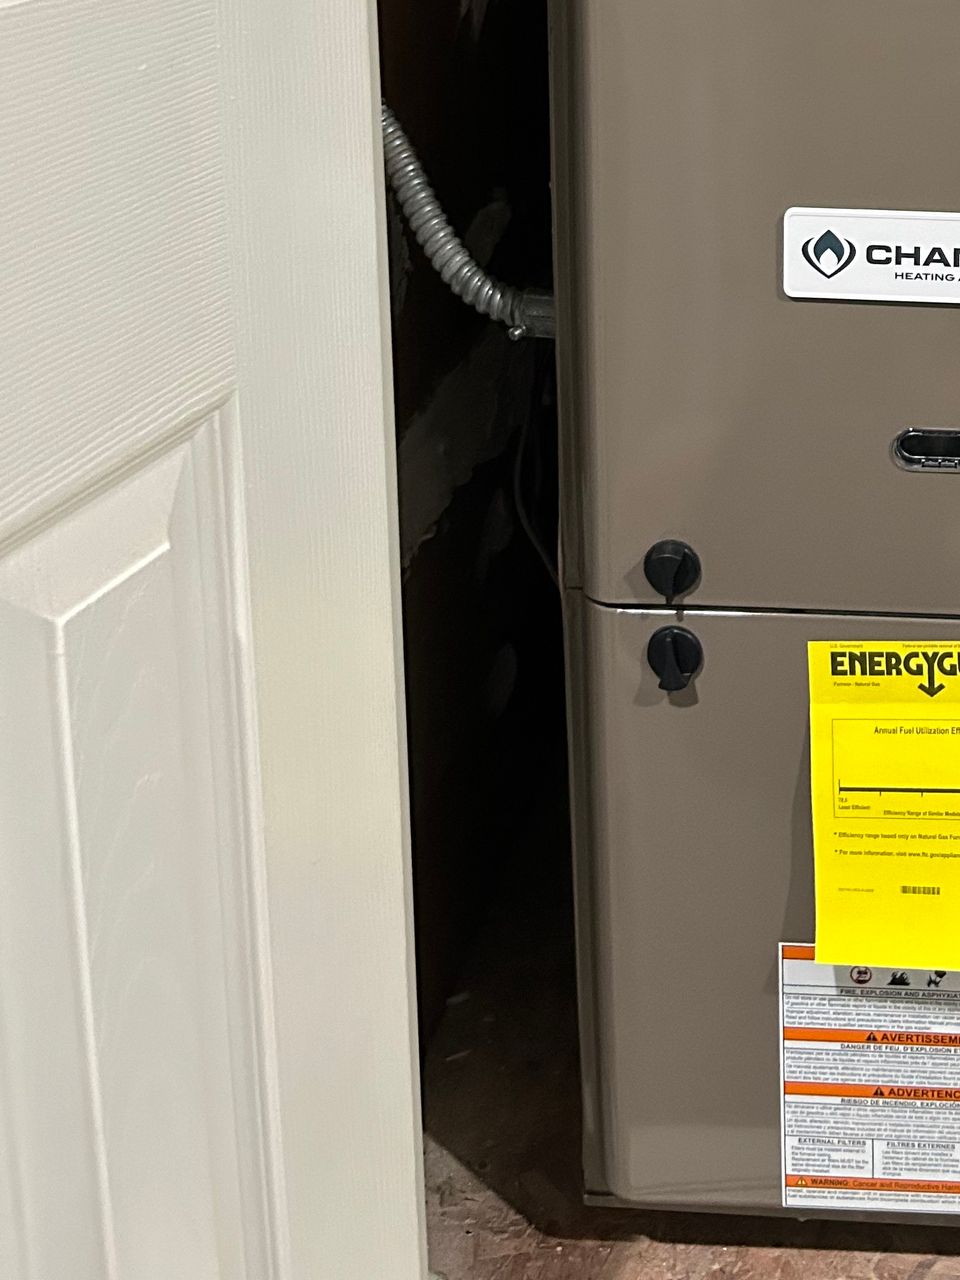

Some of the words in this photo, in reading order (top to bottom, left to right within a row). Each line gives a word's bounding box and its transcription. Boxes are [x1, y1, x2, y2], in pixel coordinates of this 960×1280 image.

[895, 272, 955, 282] HEATING
[874, 726, 897, 735] Annual
[899, 727, 914, 735] Fuel
[916, 727, 949, 735] Utilization
[860, 989, 906, 997] EXPLOSION
[852, 1180, 877, 1188] Cancer
[894, 1182, 939, 1190] Reproductive
